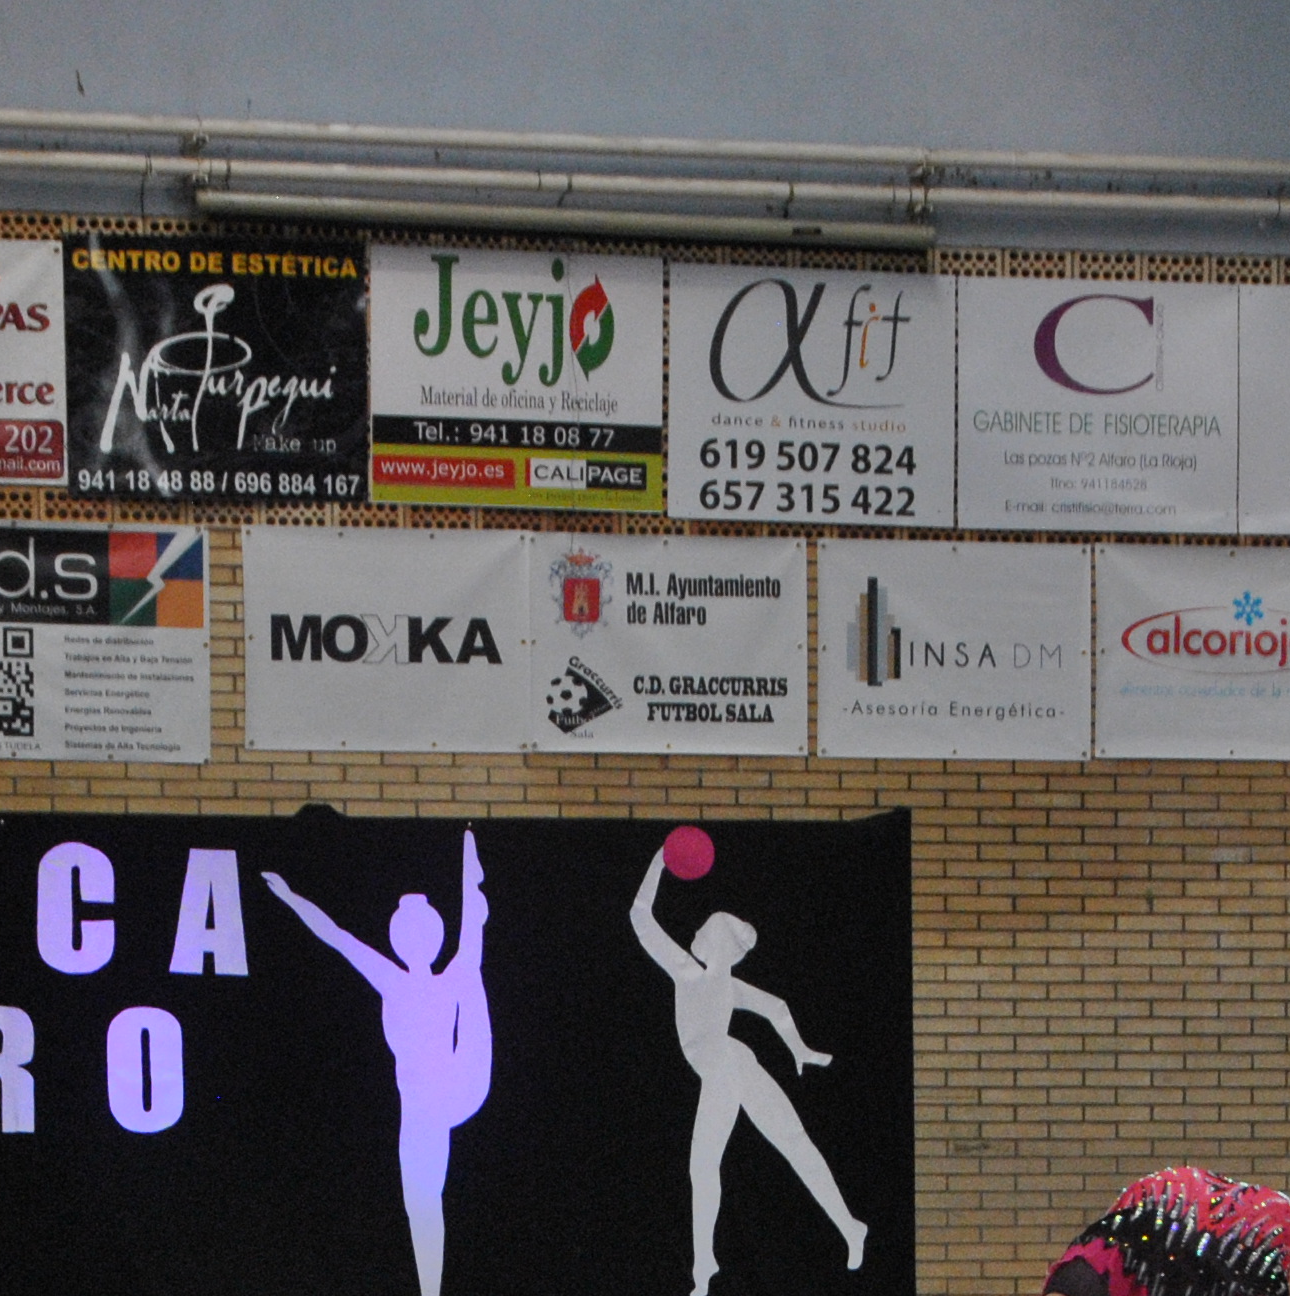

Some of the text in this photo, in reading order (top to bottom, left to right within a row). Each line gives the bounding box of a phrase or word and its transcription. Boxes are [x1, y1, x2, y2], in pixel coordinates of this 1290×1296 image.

[72, 248, 357, 277] CENTRO DE ESTÉTICA
[1034, 294, 1154, 395] C
[420, 385, 618, 417] Material de oficina y Reciclaje
[414, 421, 614, 448] Tel.: 941 18 08 77
[711, 413, 763, 427] dance
[789, 415, 844, 431] fitness
[852, 418, 906, 432] studio
[973, 410, 1221, 437] GABINETE DE FISIOTERAPIA
[5, 424, 53, 454] 202
[699, 438, 916, 476] 619 507 824
[78, 470, 115, 491] 941
[126, 470, 149, 492] 18
[156, 470, 183, 492] 48
[190, 471, 215, 492] 88
[235, 472, 271, 493] 696
[278, 473, 316, 494] 884
[323, 474, 360, 495] 167
[380, 461, 505, 481] www.jeyjo.es
[699, 480, 916, 517] 657 315 422
[626, 572, 781, 601] M.I. Ayuntamiento
[627, 602, 707, 626] de Alfaro
[1013, 642, 1063, 669] DM
[633, 676, 788, 697] C.D. GRACCURRIS
[648, 702, 774, 723] FUTBOL SALA
